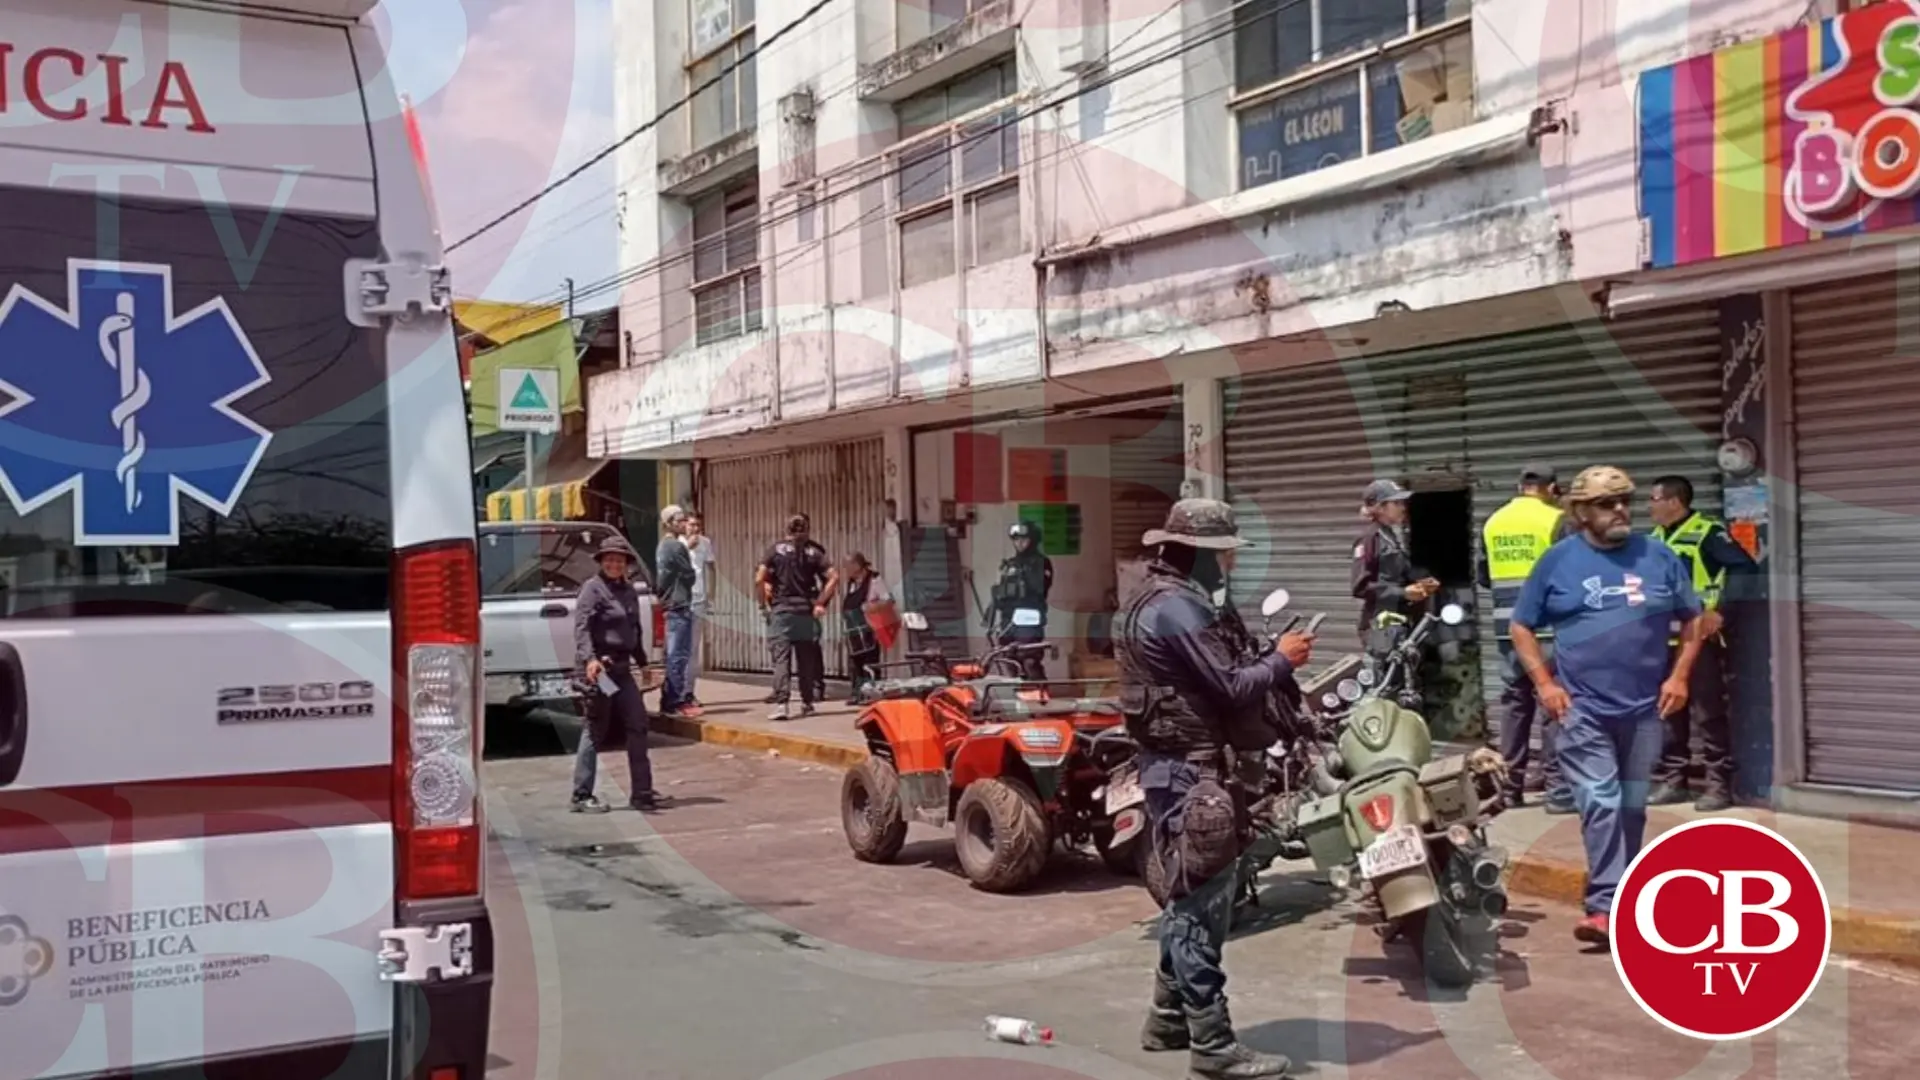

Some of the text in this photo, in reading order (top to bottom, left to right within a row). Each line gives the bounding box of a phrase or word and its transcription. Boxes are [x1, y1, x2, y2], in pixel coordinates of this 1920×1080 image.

[504, 413, 554, 423] PRIORIDAD
[217, 680, 374, 706] 2500
[67, 899, 270, 940] BENEFICENCIA
[68, 934, 197, 968] PÚBLICA
[69, 964, 173, 987] ADMINISTRACIÓN
[175, 960, 197, 975] DEL
[69, 967, 241, 999] DE LA BENEFICENCIA PÚBLICA
